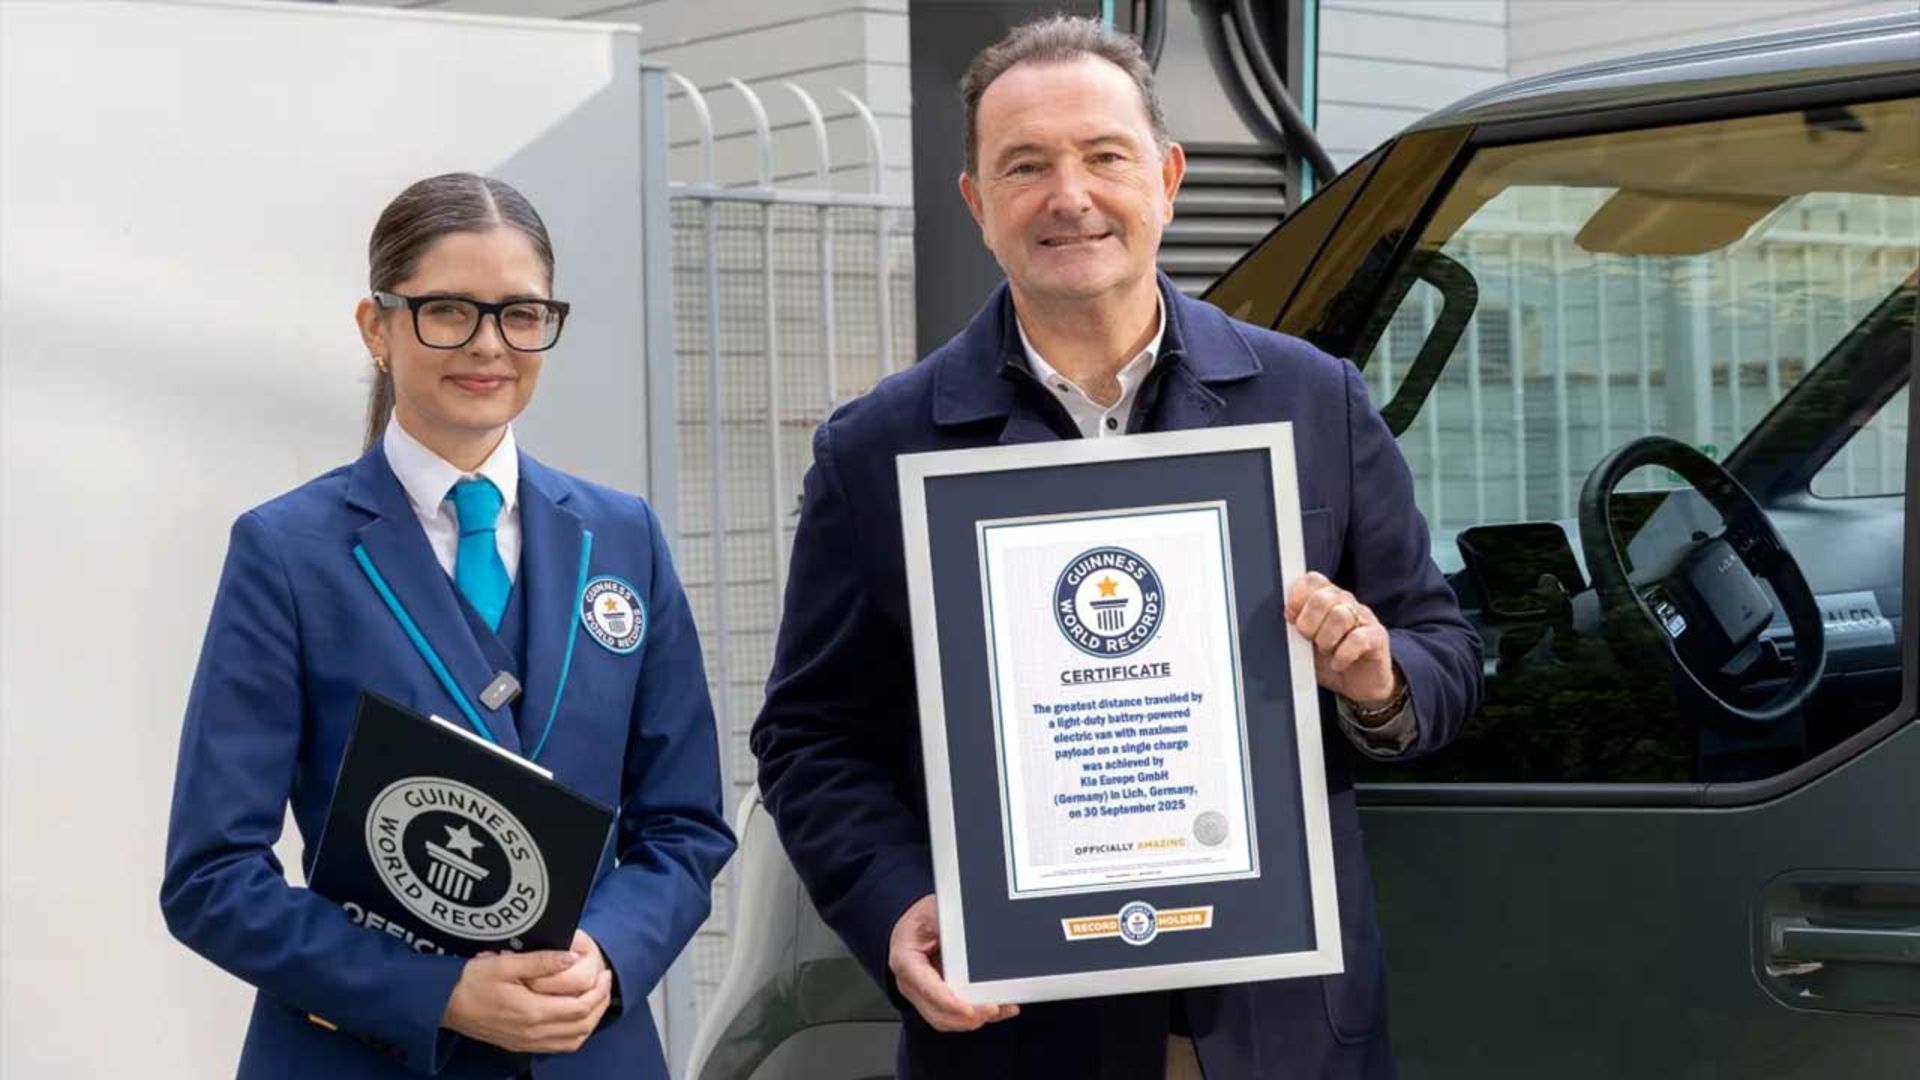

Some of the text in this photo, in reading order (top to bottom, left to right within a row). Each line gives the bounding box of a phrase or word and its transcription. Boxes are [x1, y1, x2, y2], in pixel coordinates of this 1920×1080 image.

[1067, 553, 1148, 586] GUINNESS
[585, 582, 632, 603] GUINNESS
[585, 609, 642, 648] WORLD RECORDS
[1060, 591, 1158, 652] WORLD RECORDS
[1060, 662, 1171, 684] CERTIFICATE
[1033, 691, 1202, 715] The greatest distance travelled by
[1049, 708, 1190, 730] a light-duty battery-powered
[1054, 724, 1188, 743] electric van with maximum
[1055, 739, 1189, 760] payload on a single charge
[1083, 756, 1164, 771] was achieved by
[1081, 770, 1169, 787] Kia Europe GmbH
[1054, 786, 1199, 806] (Germany) in Lich, Germany,
[1069, 799, 1186, 819] on 30 September 2025
[404, 788, 530, 862] GUINNESS
[1074, 838, 1186, 856] OFFICIALLY AMAZING
[378, 815, 536, 930] WORLD RECORDS
[1073, 914, 1201, 933] RECORD HOLDER
